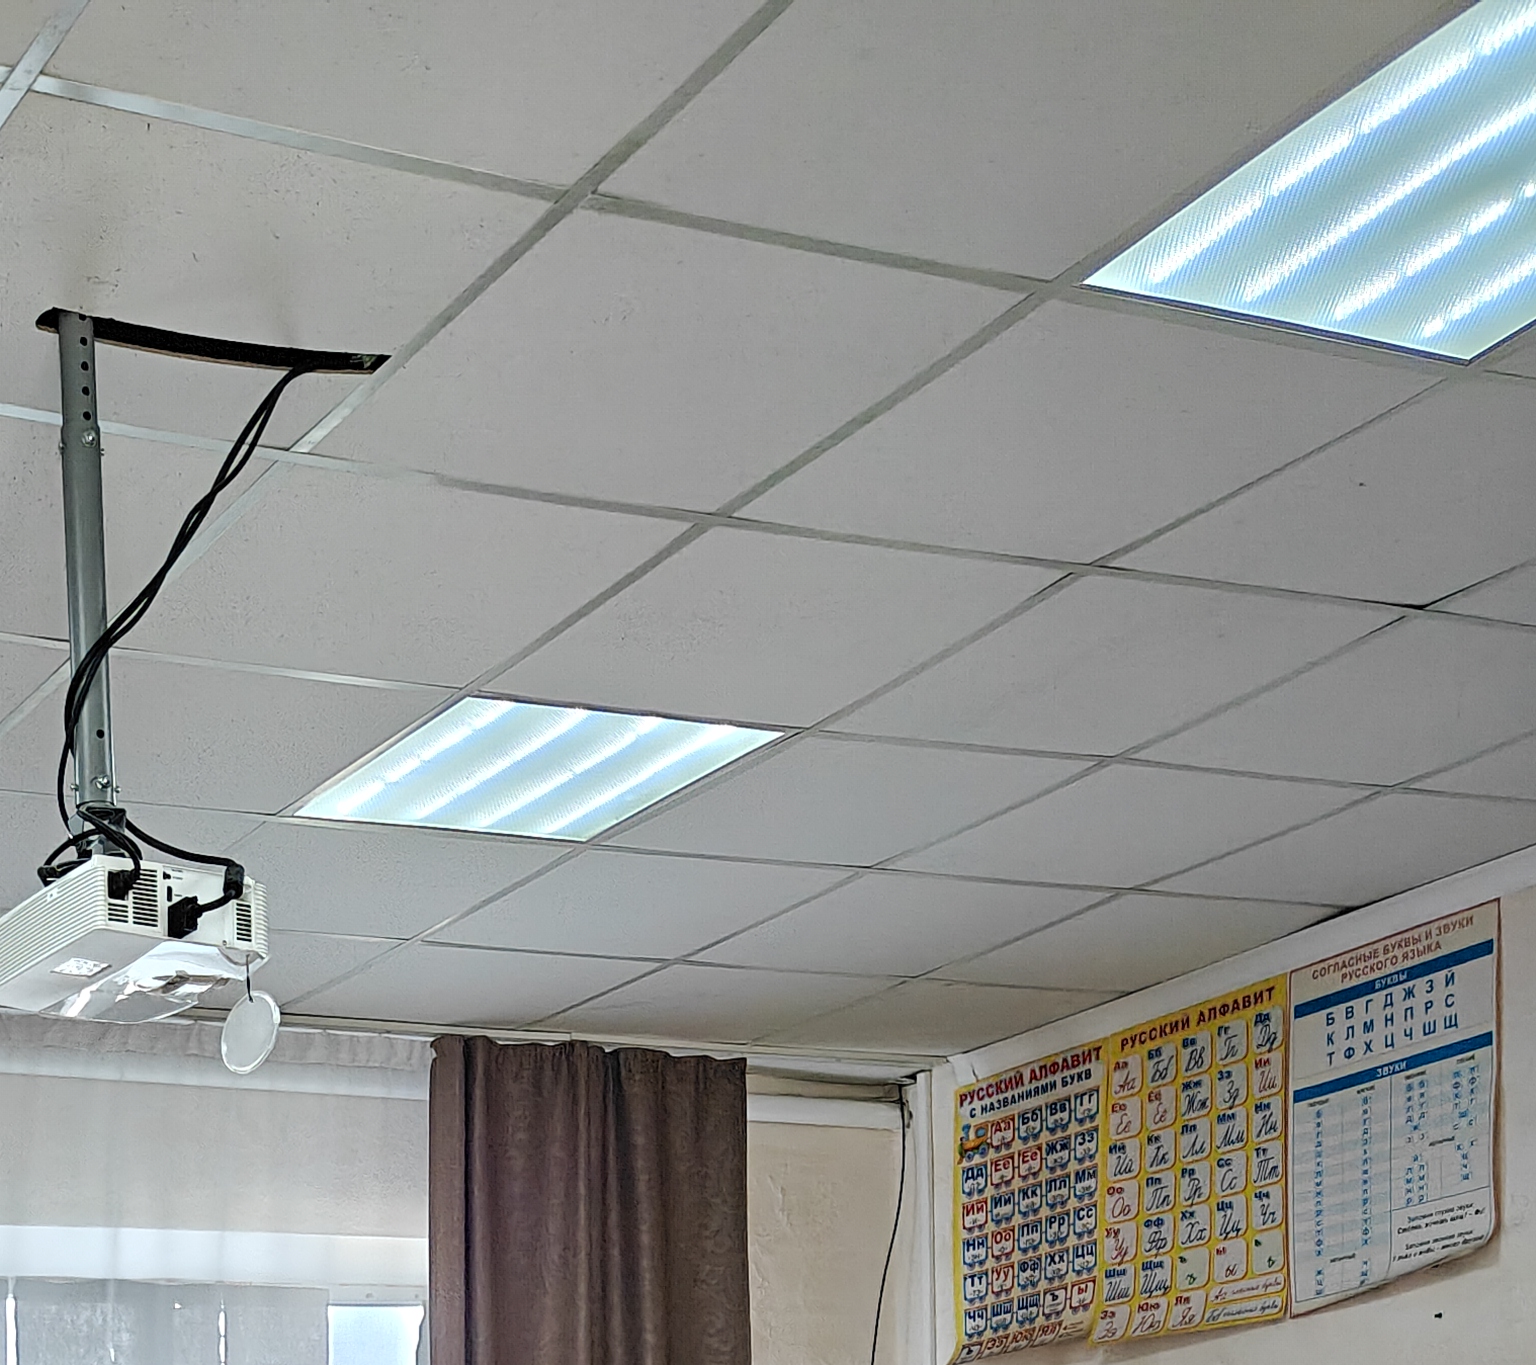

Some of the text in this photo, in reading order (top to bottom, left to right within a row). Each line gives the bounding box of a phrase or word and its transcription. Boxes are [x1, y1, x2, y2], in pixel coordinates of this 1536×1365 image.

[1312, 915, 1474, 980] СОГЛАСНЫЕ БУКВЫ И ЗВУКИ
[1341, 940, 1442, 983] РУССКОГО ЯЗЫКА
[1326, 969, 1455, 1027] Б В Г Д Ж З Й
[1375, 971, 1408, 990] БУКВЫ
[1120, 985, 1275, 1052] РУССКИЙ АЛФАВИТ
[1326, 993, 1455, 1047] К Л М Н П Р С
[1326, 1012, 1459, 1066] Т Ф Х Ц Ч Ш Щ
[959, 1046, 1103, 1107] РУССКИЙ АЛФАВИТ
[969, 1069, 1092, 1118] С НАЗВАНИЯМИ БУКВ
[1376, 1061, 1408, 1079] ЗВУКИ
